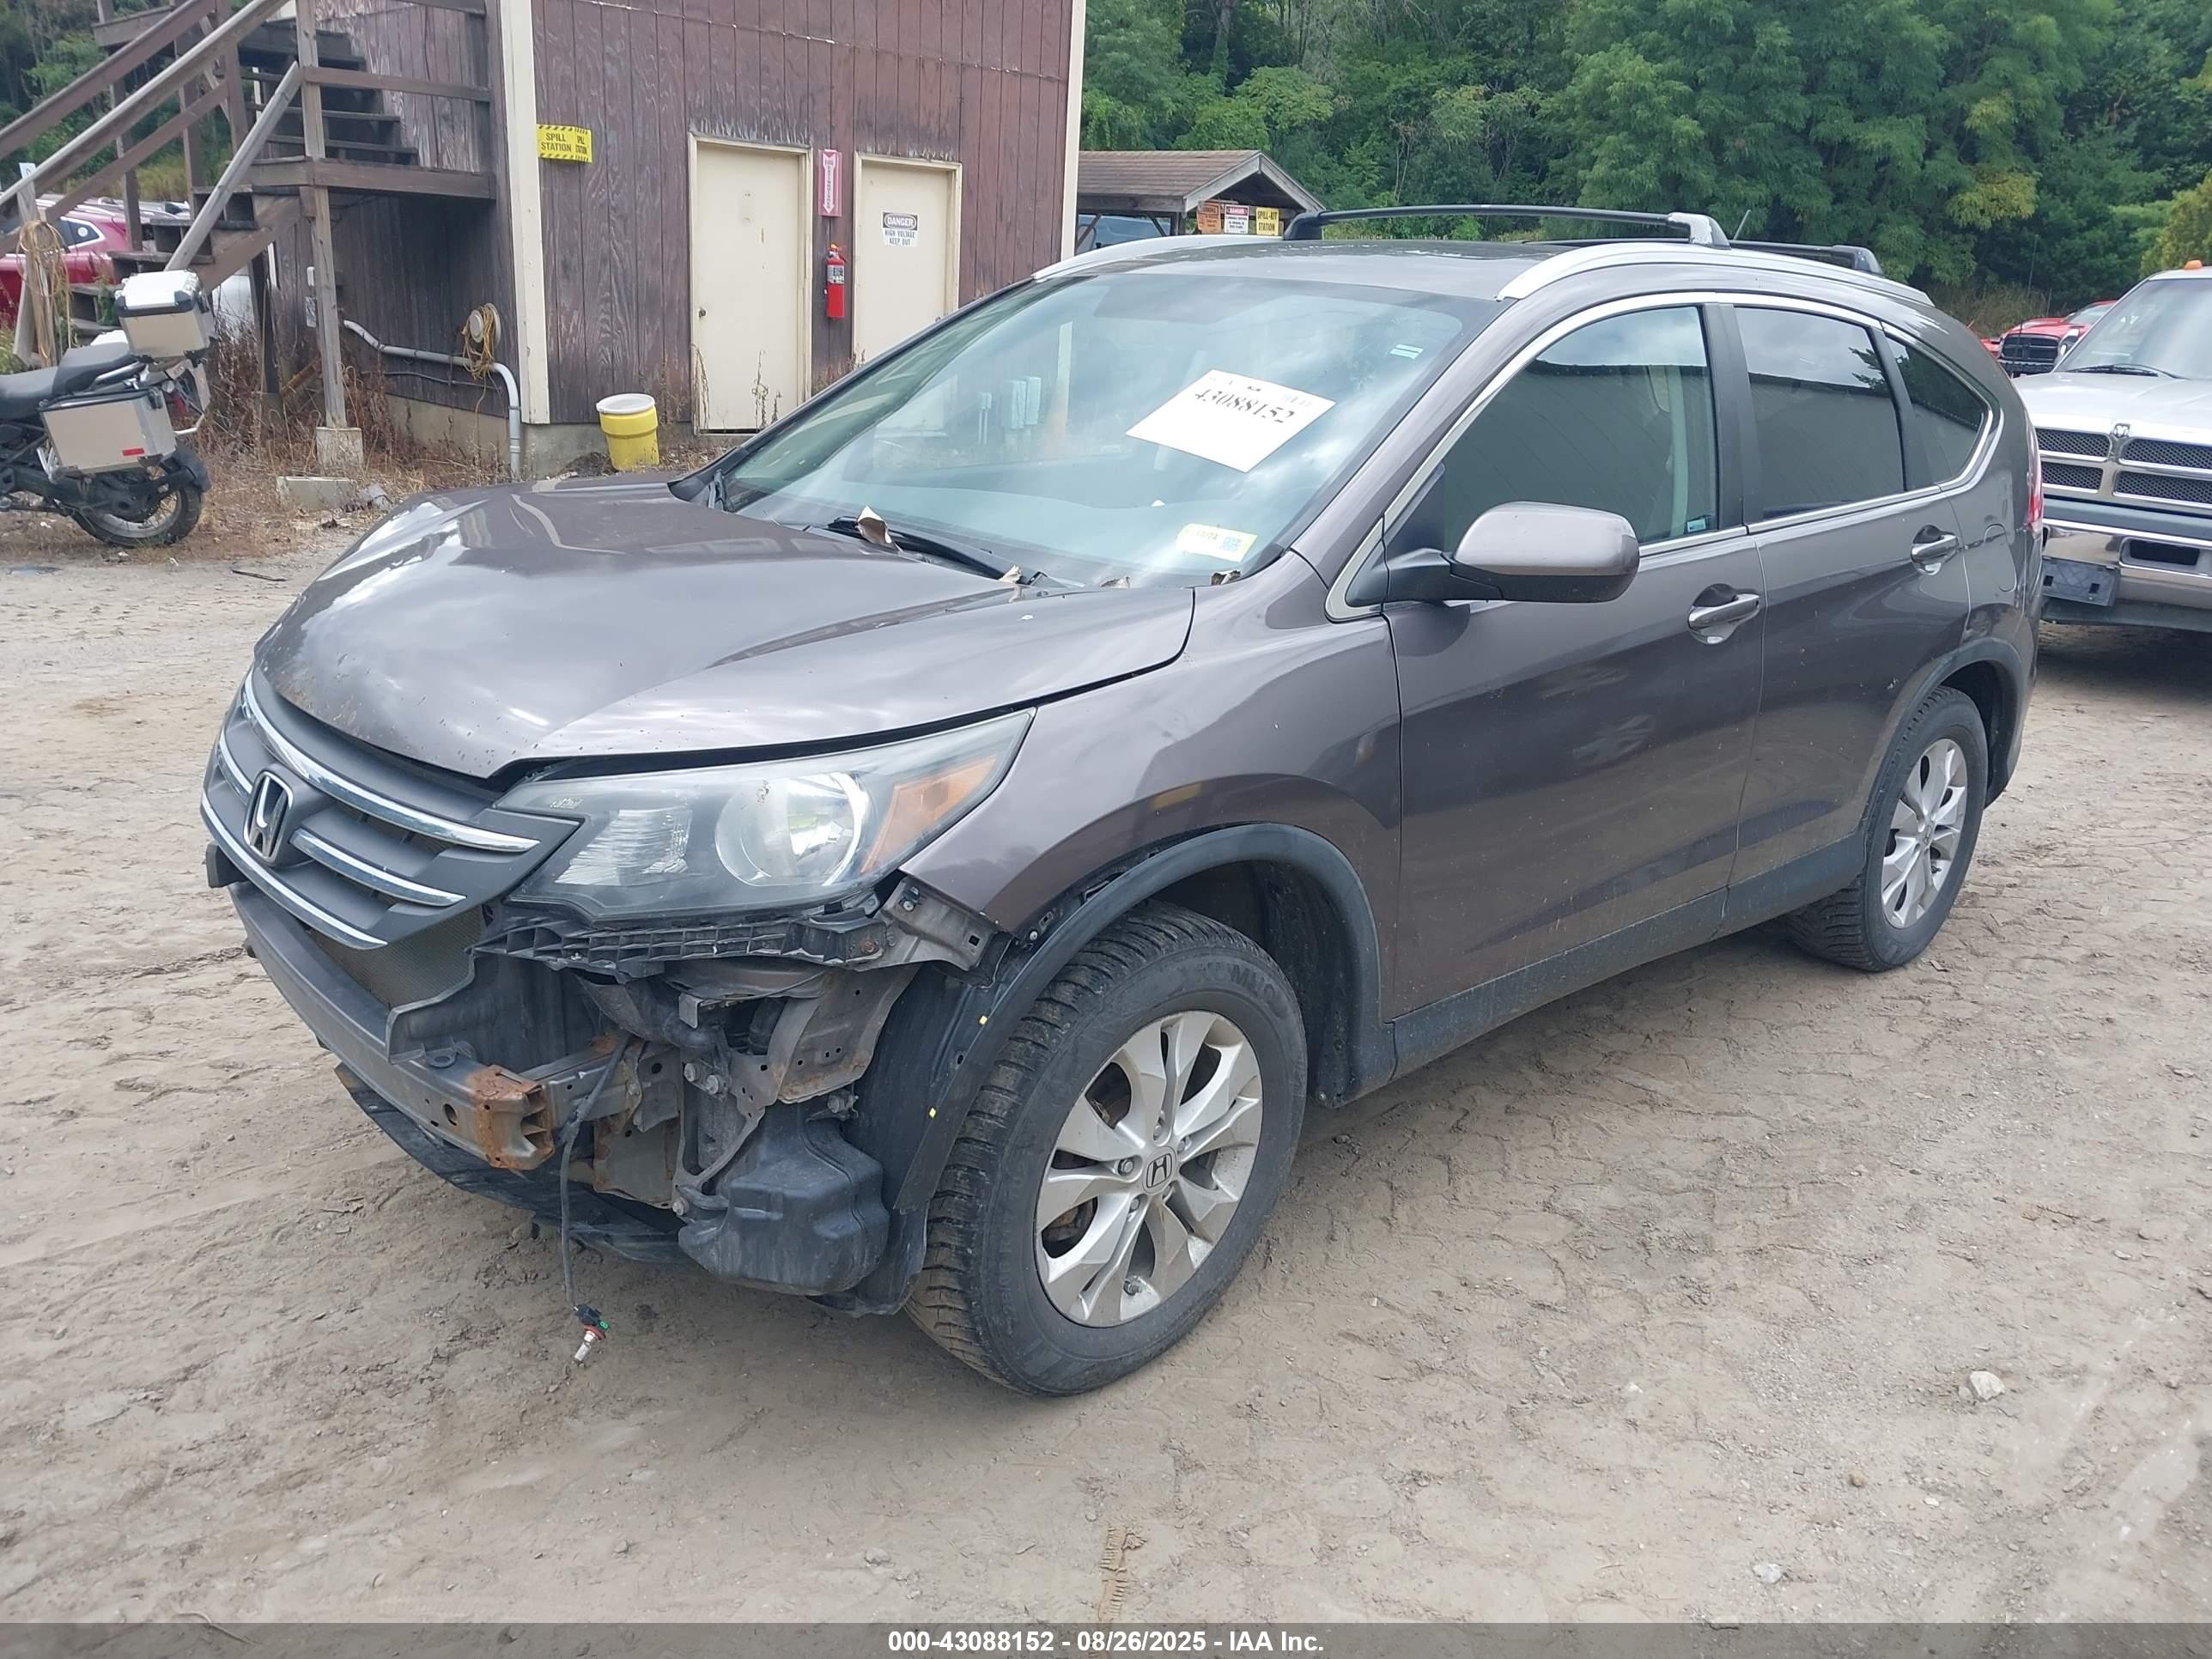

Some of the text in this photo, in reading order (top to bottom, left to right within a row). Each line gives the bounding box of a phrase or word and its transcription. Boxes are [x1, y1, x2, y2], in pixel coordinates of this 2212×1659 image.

[546, 132, 567, 142] SPILL
[541, 142, 572, 152] STATION
[887, 216, 914, 227] DANGER
[1259, 222, 1275, 232] STATION
[885, 228, 915, 239] HIGH VOLTAGE
[889, 237, 911, 246] KEEP OUT
[1194, 388, 1296, 423] 43088152
